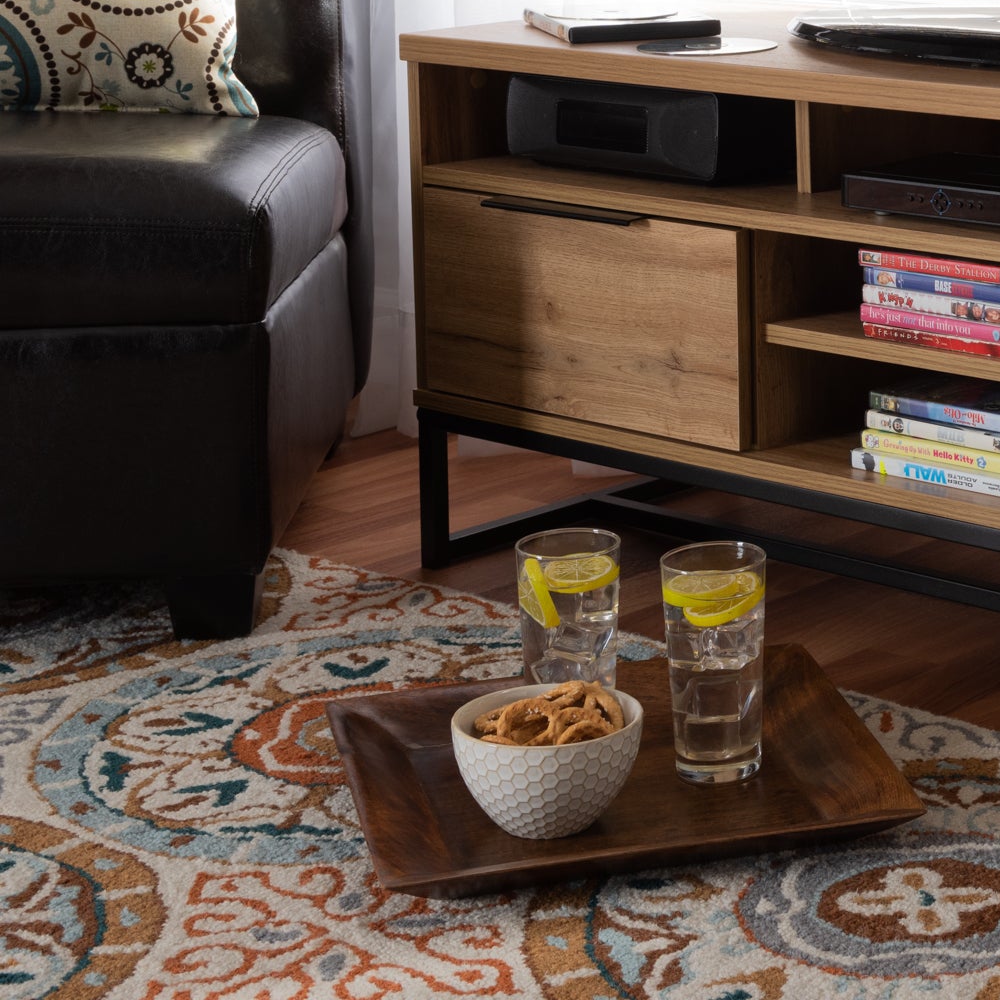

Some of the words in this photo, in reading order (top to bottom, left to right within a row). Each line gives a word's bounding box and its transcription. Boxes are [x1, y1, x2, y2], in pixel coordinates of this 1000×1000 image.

[898, 256, 917, 268] THE
[920, 259, 951, 273] DERBY
[954, 264, 997, 280] STALLION
[869, 307, 885, 319] he's
[885, 311, 901, 324] just
[902, 316, 917, 325] not
[918, 315, 935, 328] that
[936, 318, 954, 332] into
[954, 324, 971, 336] you
[943, 408, 961, 419] Otis
[967, 412, 986, 425] Milo
[933, 449, 953, 460] Hello
[953, 453, 974, 465] Kitty
[947, 473, 978, 483] ADULTS
[947, 479, 973, 488] OLDER
